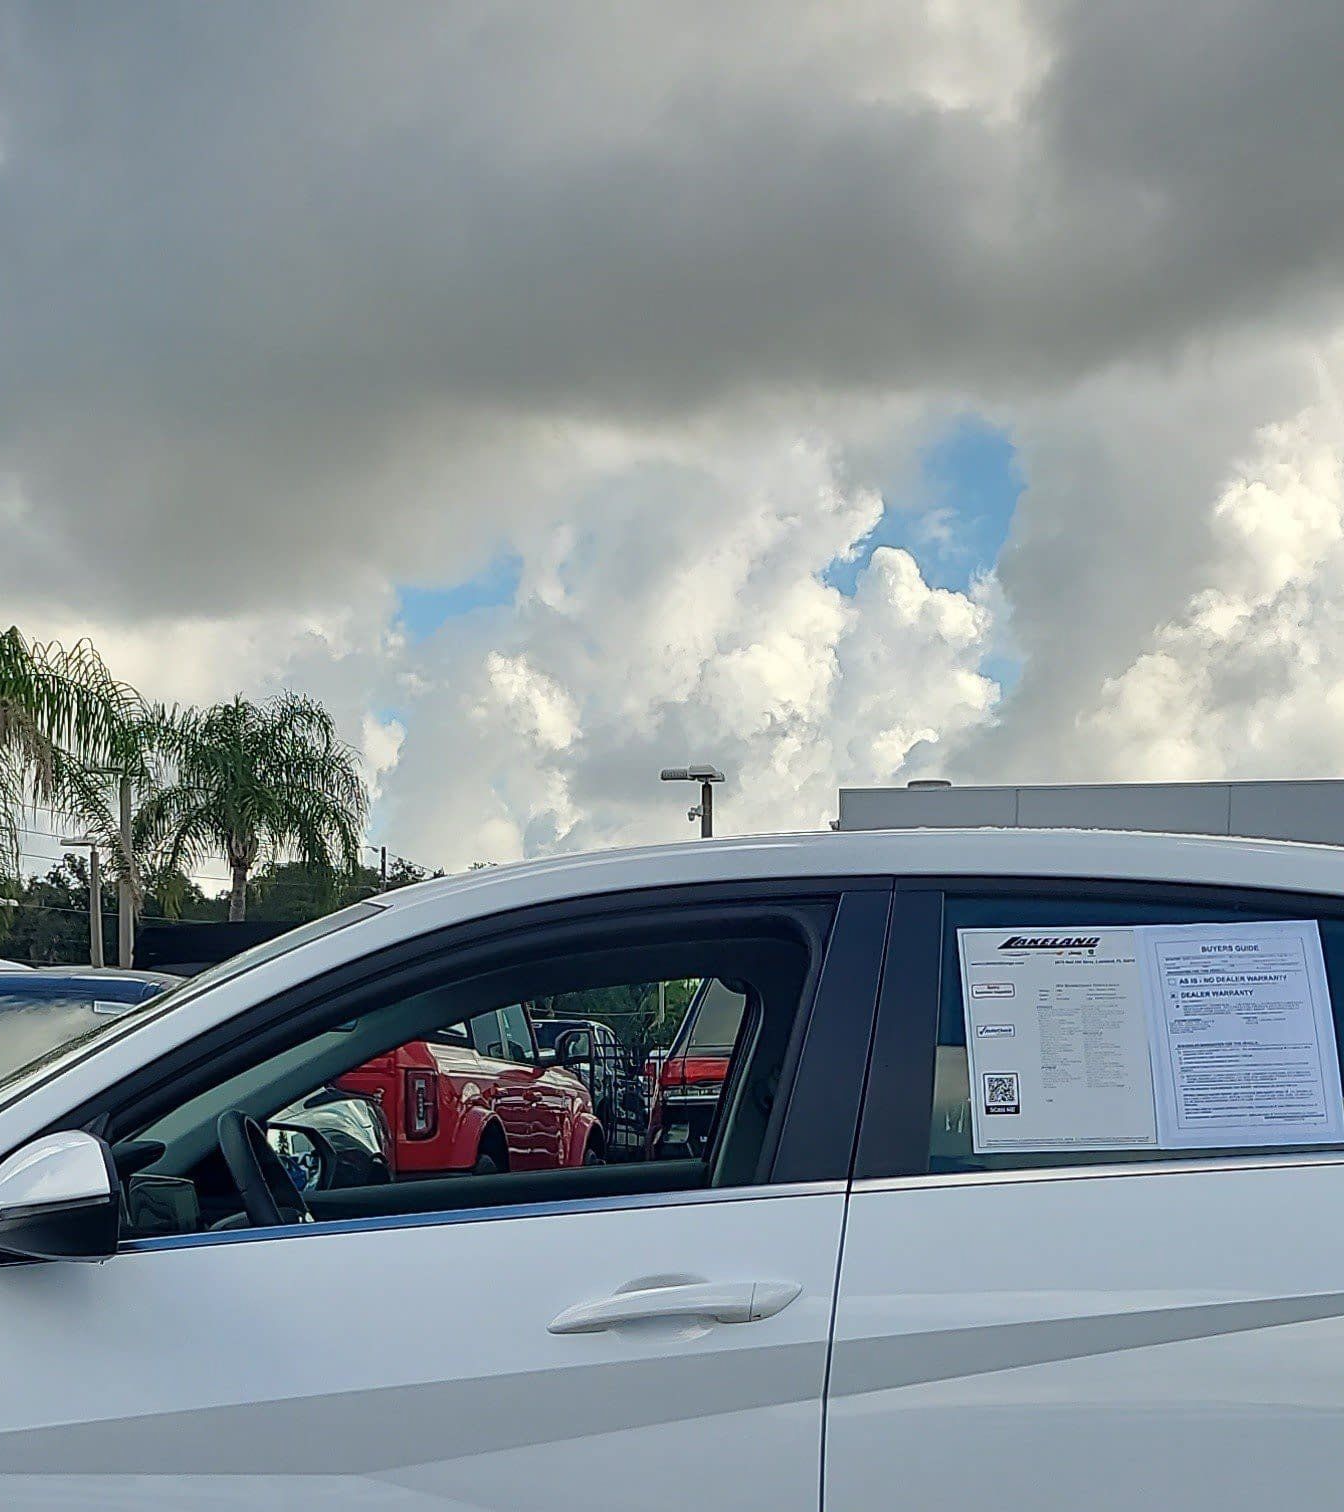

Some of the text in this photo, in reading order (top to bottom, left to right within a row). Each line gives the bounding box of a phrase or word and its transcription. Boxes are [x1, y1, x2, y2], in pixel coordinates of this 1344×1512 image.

[997, 936, 1101, 950] LAKELAND
[1201, 945, 1233, 953] BUYERS
[1212, 989, 1254, 997] WARRANTY
